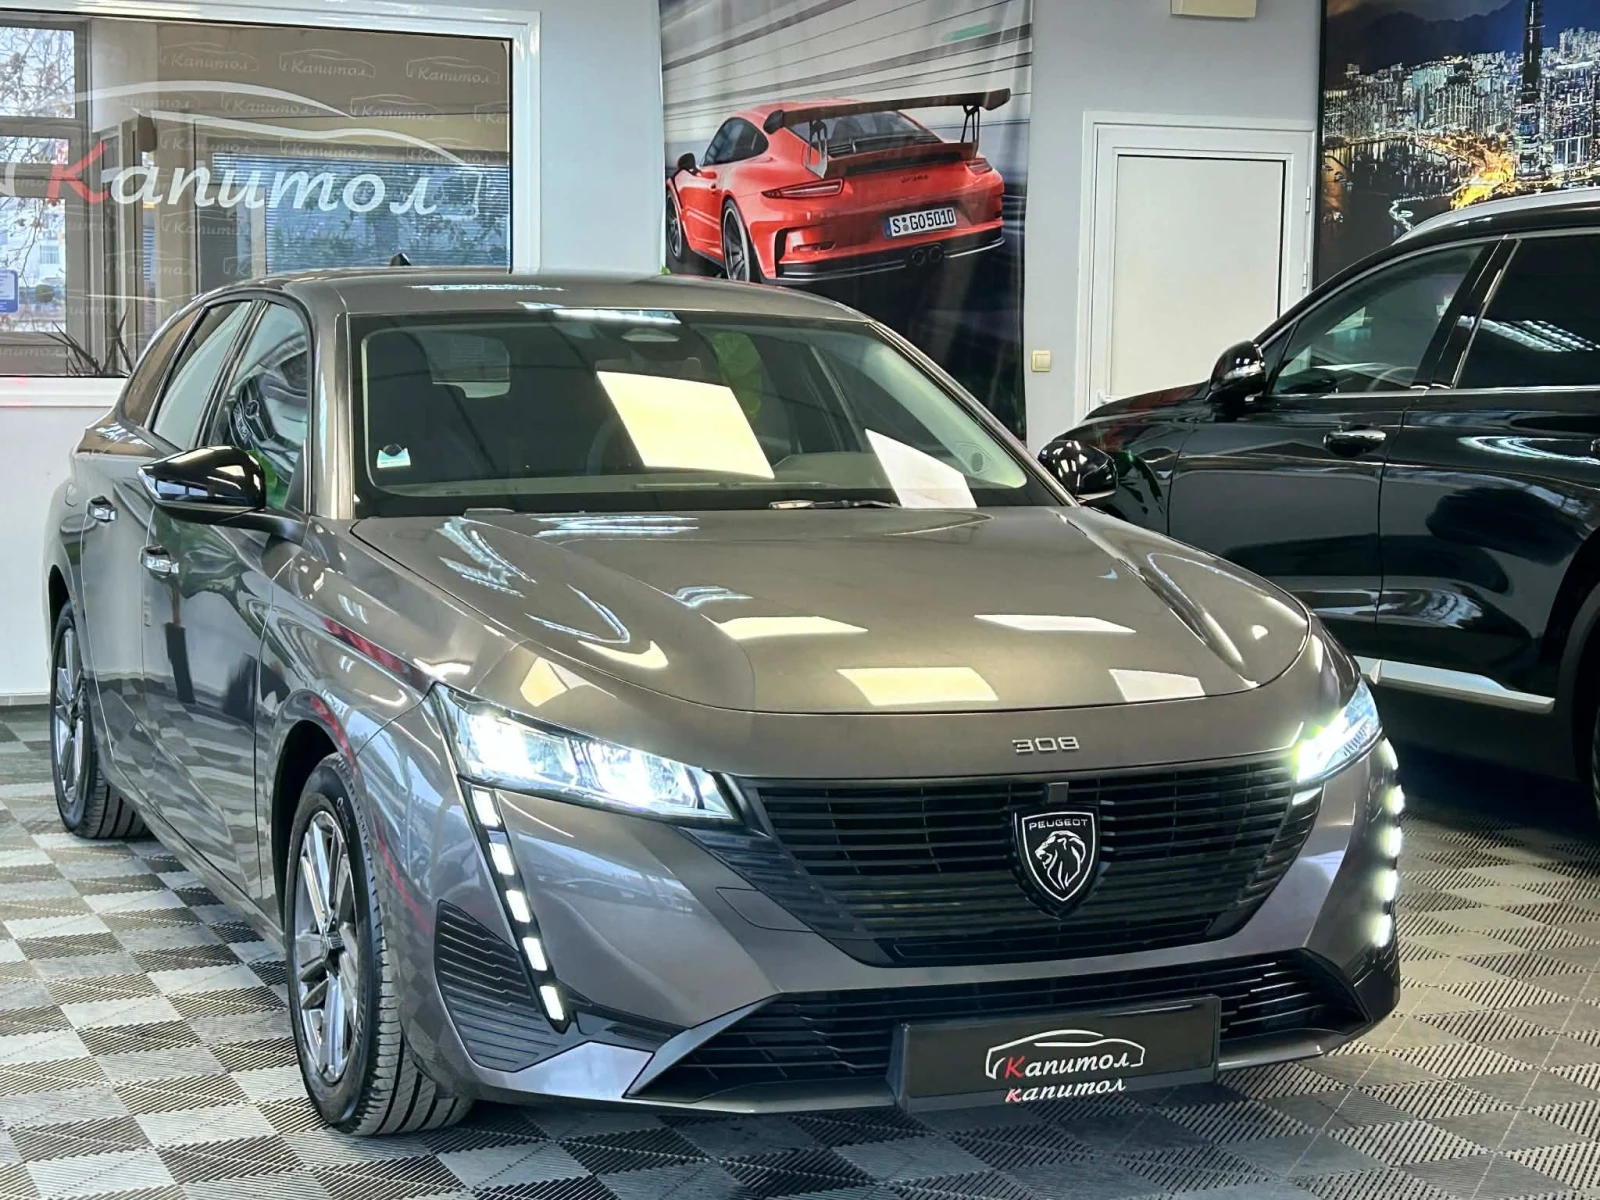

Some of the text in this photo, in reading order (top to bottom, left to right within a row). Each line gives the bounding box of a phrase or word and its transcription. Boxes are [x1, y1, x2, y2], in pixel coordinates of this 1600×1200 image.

[171, 52, 249, 71] Капитол
[291, 59, 366, 77] Капитол
[417, 67, 490, 84] Капитол
[46, 139, 437, 215] Капитол
[1012, 736, 1080, 753] 308
[1029, 817, 1088, 831] PEUGEOT
[1004, 1052, 1130, 1079] Капитол
